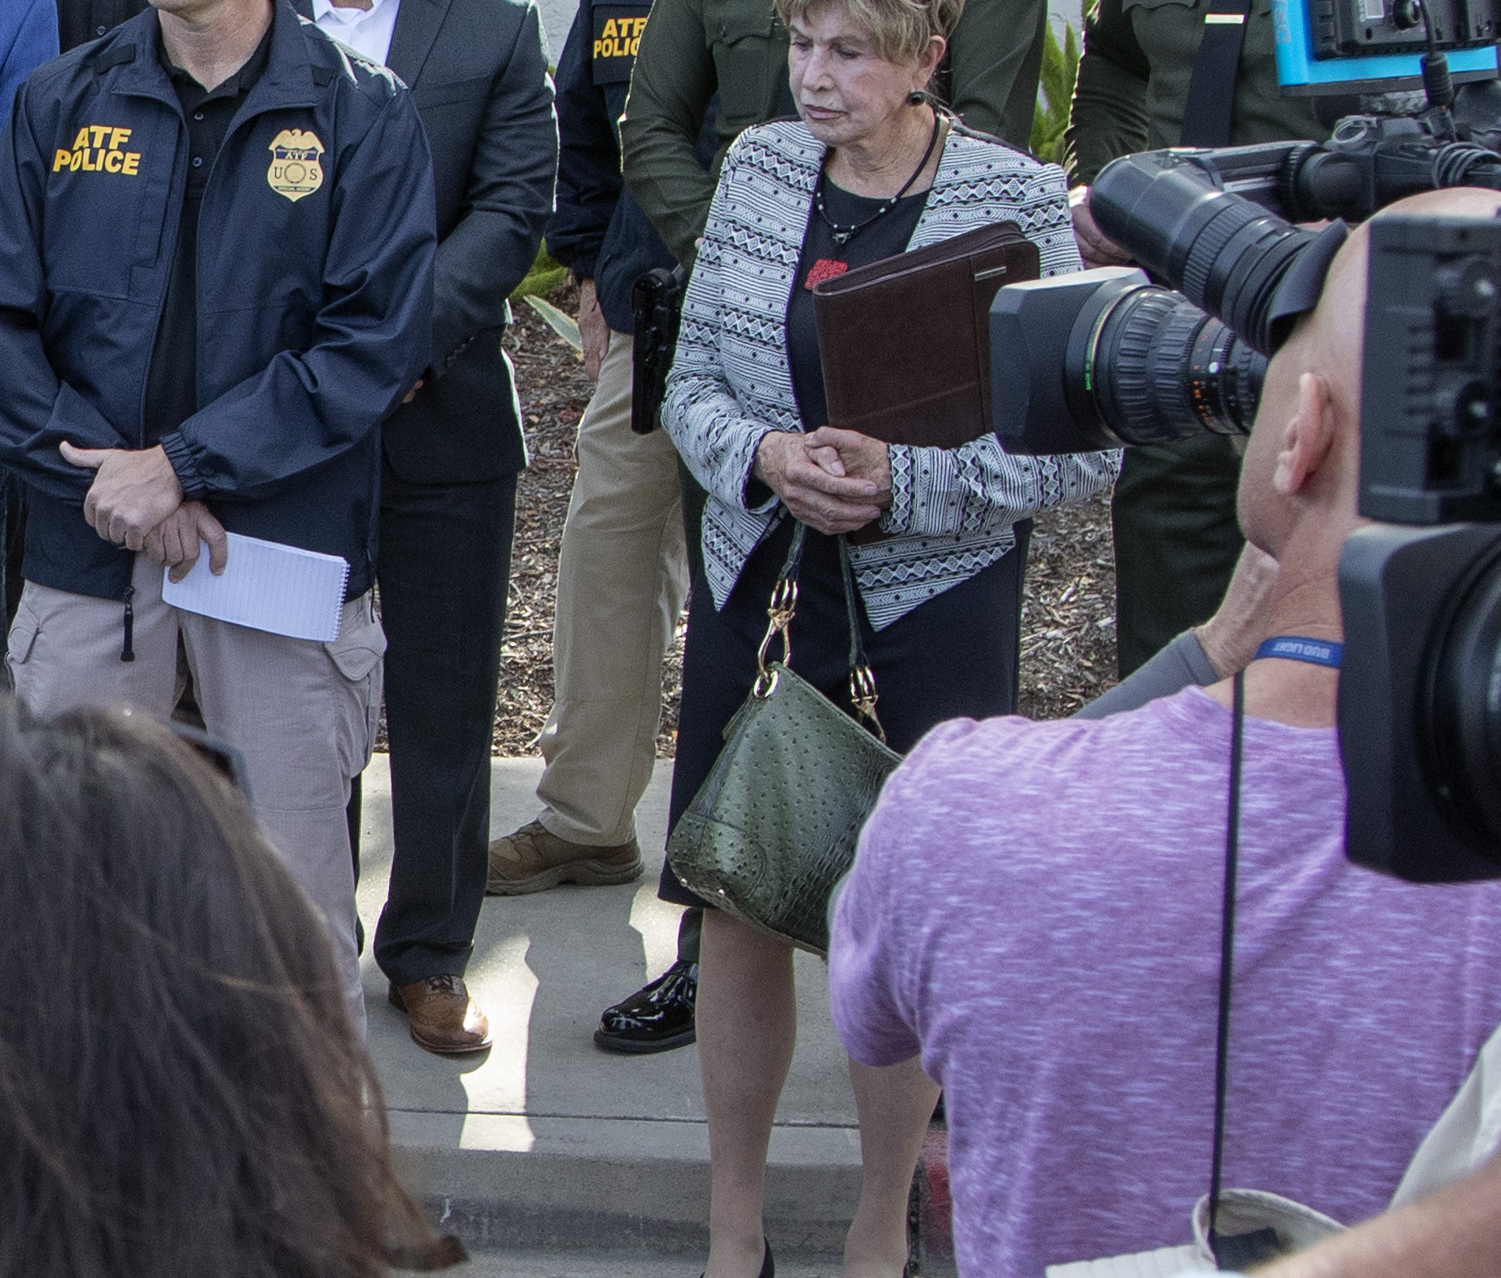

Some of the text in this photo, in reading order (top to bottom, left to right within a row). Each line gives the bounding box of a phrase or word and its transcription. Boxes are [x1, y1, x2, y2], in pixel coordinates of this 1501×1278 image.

[593, 37, 640, 59] POLIC
[72, 125, 132, 151] ATF
[53, 148, 141, 175] POLICE
[284, 150, 308, 160] ATF
[273, 166, 318, 180] U S
